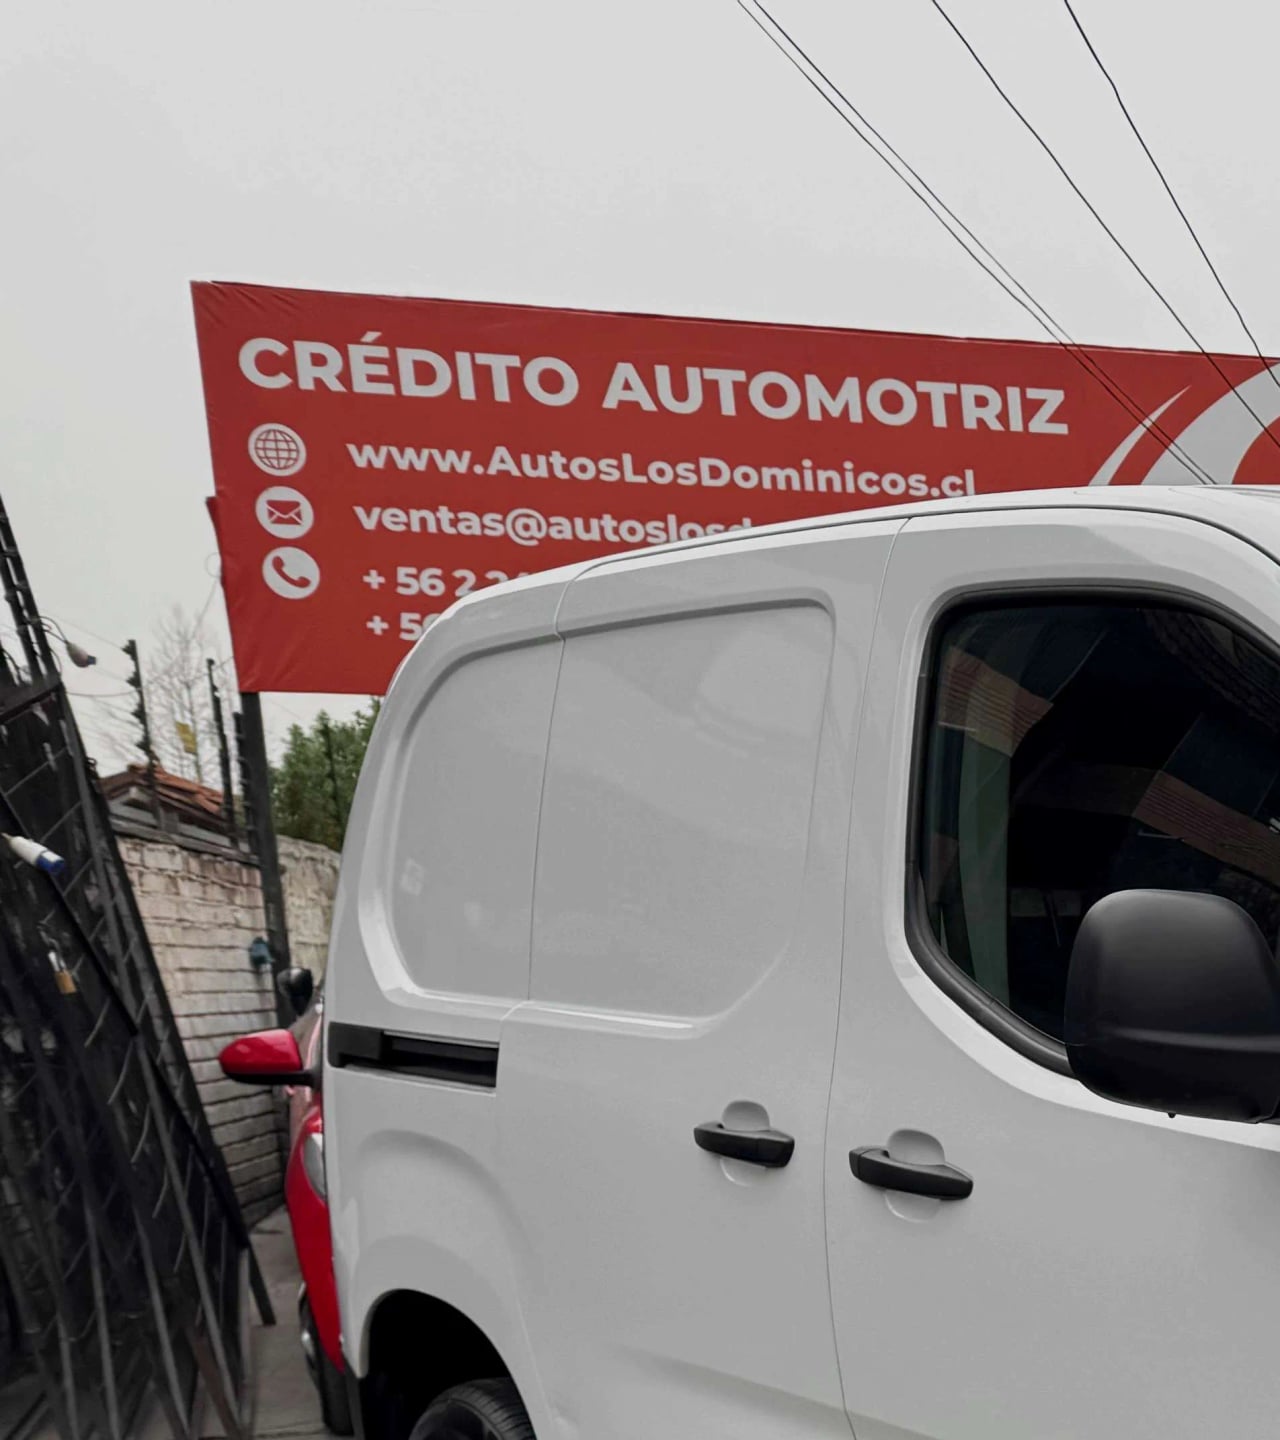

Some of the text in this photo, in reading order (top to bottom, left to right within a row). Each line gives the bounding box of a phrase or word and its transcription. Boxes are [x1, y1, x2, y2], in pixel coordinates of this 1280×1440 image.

[238, 331, 1069, 436] CRÉDITO AUTOMOTRIZ
[346, 442, 976, 498] www.AutosLosDominicos.cl
[396, 566, 446, 597] 56
[399, 611, 442, 641] 5
